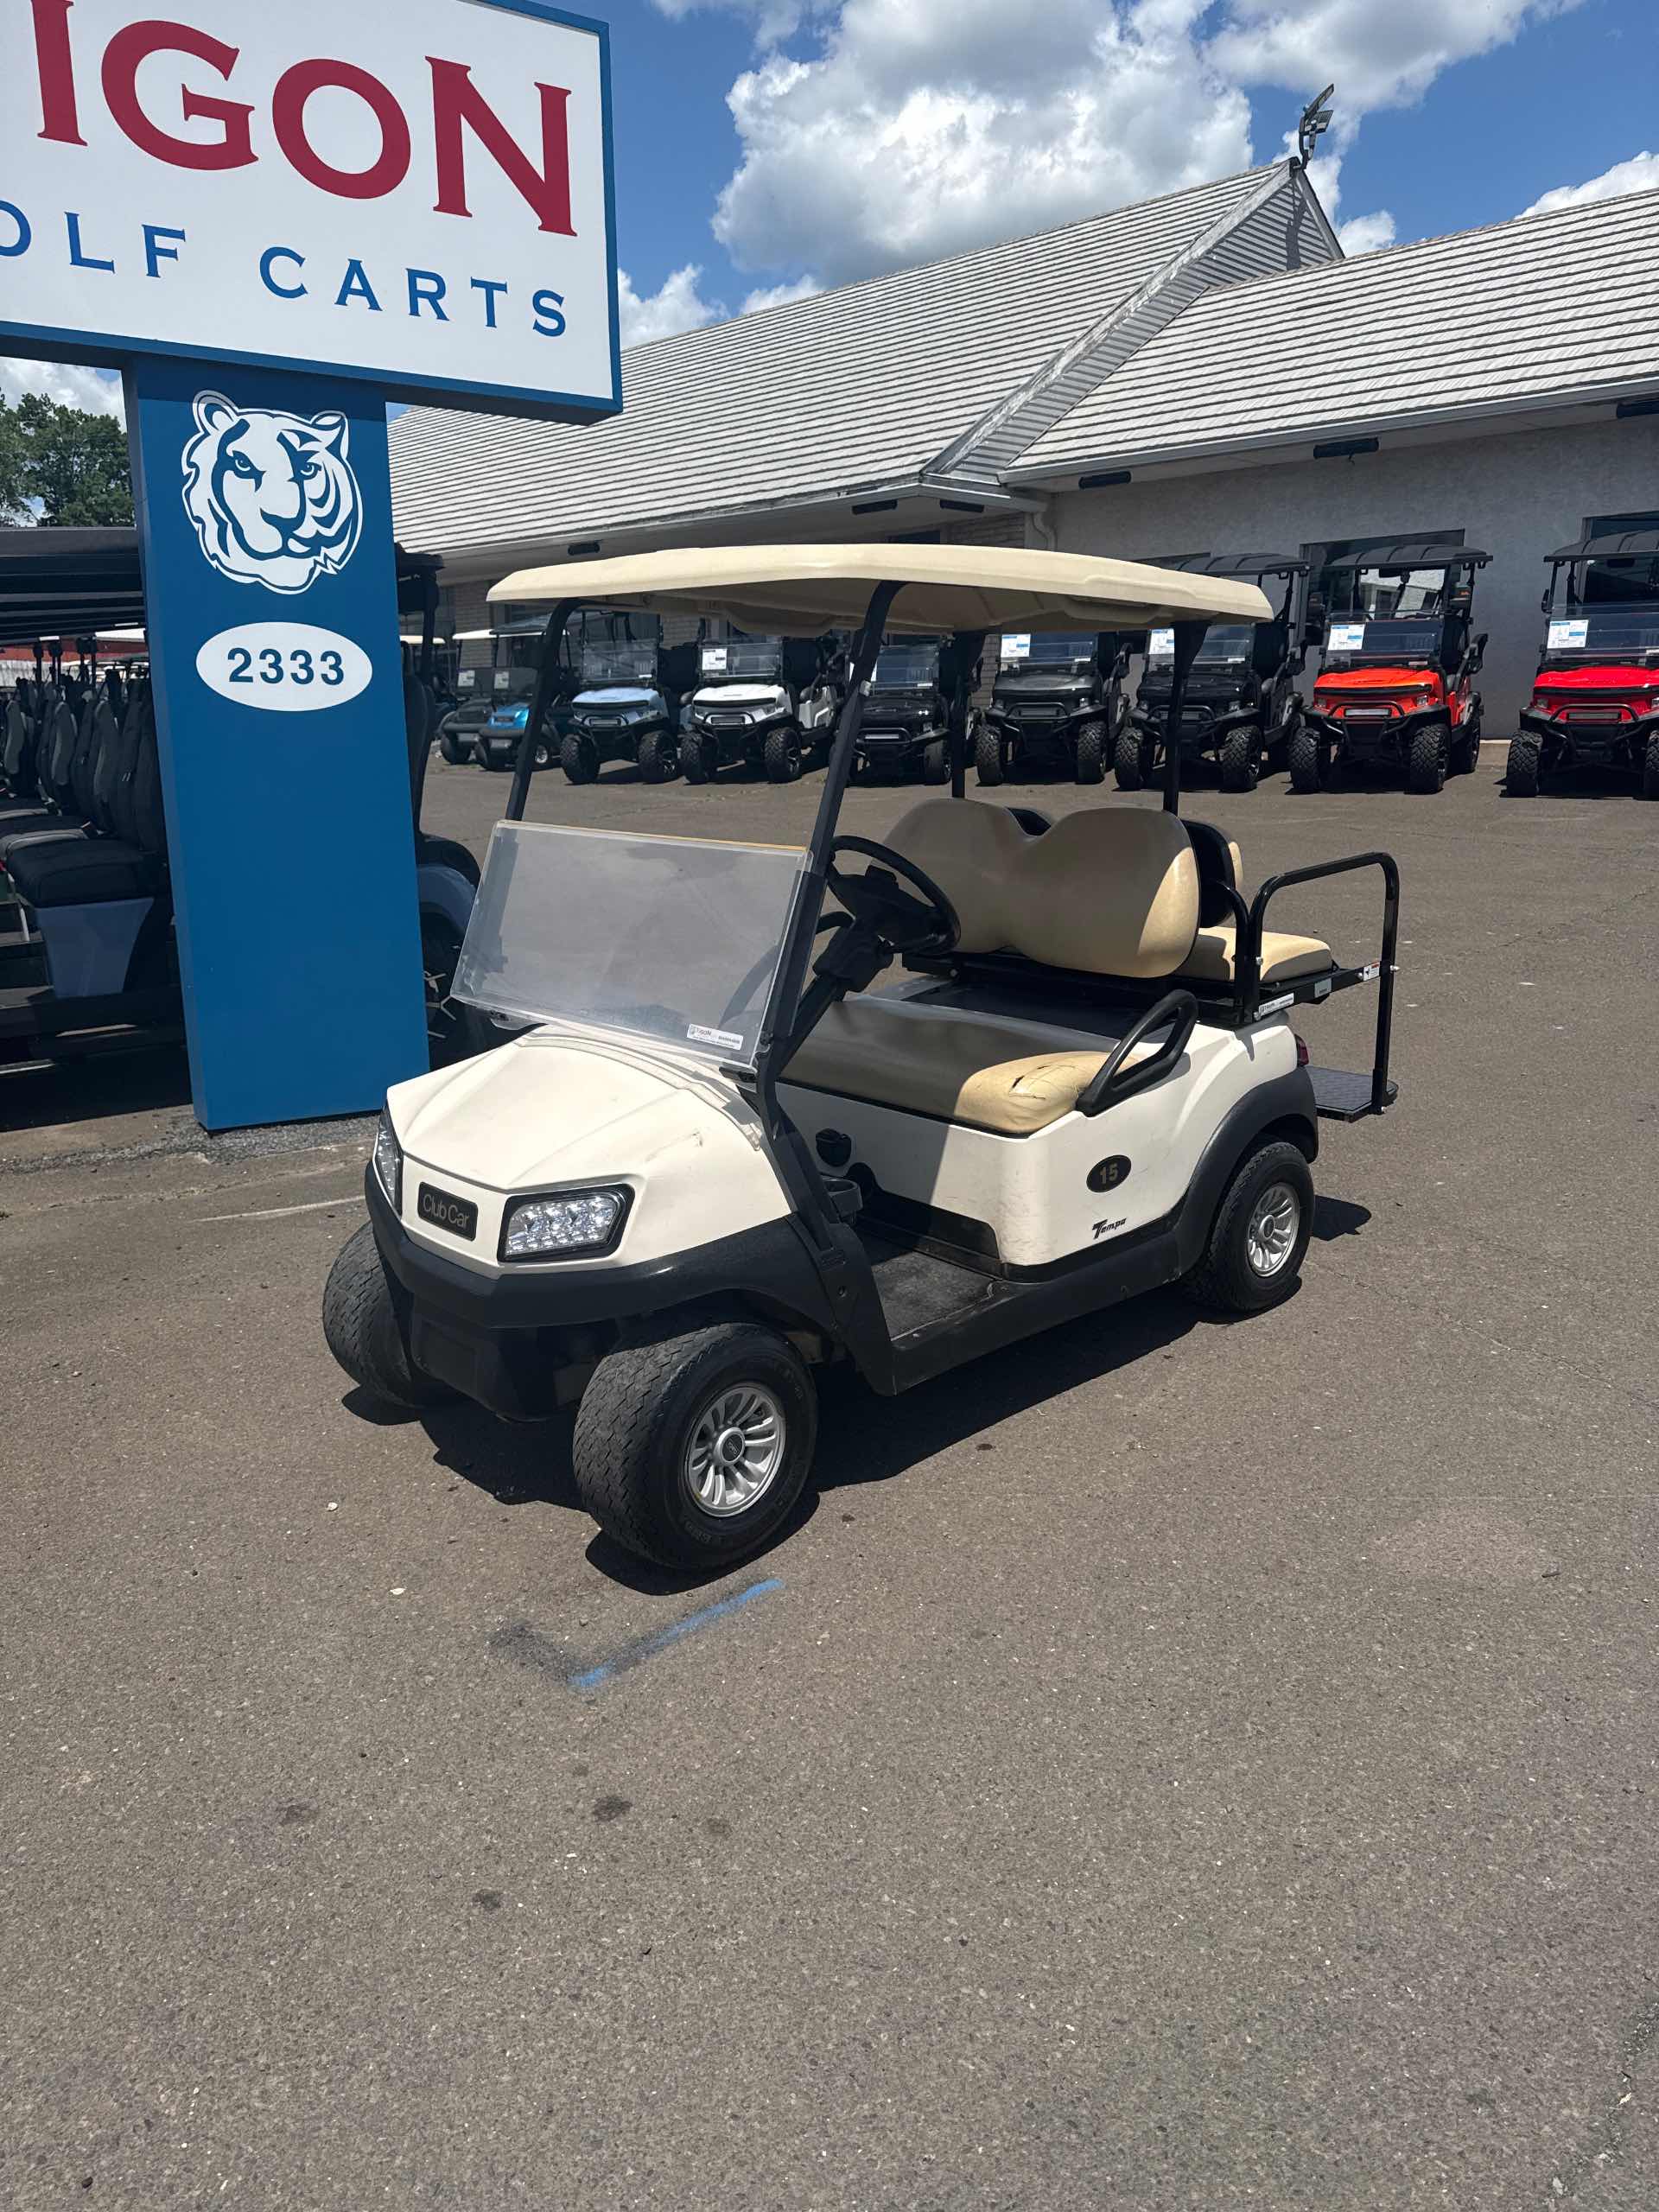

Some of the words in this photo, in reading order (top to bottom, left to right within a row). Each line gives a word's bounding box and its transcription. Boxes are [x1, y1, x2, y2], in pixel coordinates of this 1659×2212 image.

[31, 0, 577, 237] IGON
[259, 246, 567, 338] CARTS
[227, 647, 344, 685] 2333
[1100, 1162, 1118, 1184] 15
[423, 1194, 447, 1221] Club
[448, 1205, 469, 1228] Car
[1092, 1217, 1127, 1239] Tempo
